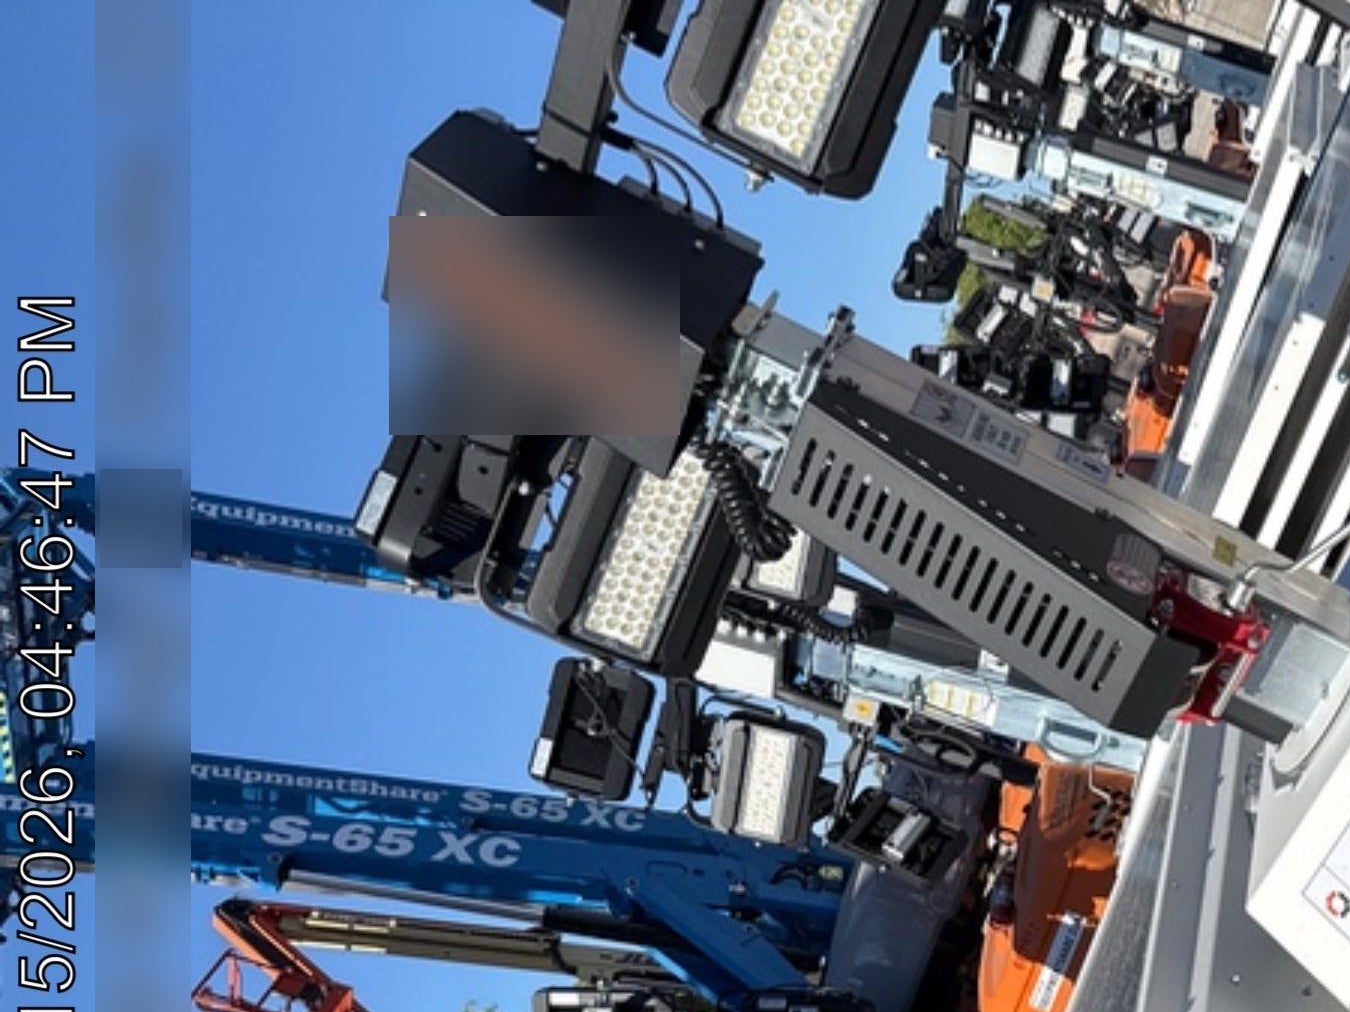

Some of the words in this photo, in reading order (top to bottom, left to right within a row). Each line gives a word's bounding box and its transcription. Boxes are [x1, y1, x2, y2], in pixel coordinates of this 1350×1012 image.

[191, 763, 440, 802] quipmentShare
[459, 789, 568, 822] S-65
[580, 795, 646, 831] XC
[261, 815, 417, 857] S-65
[430, 831, 522, 867] XC
